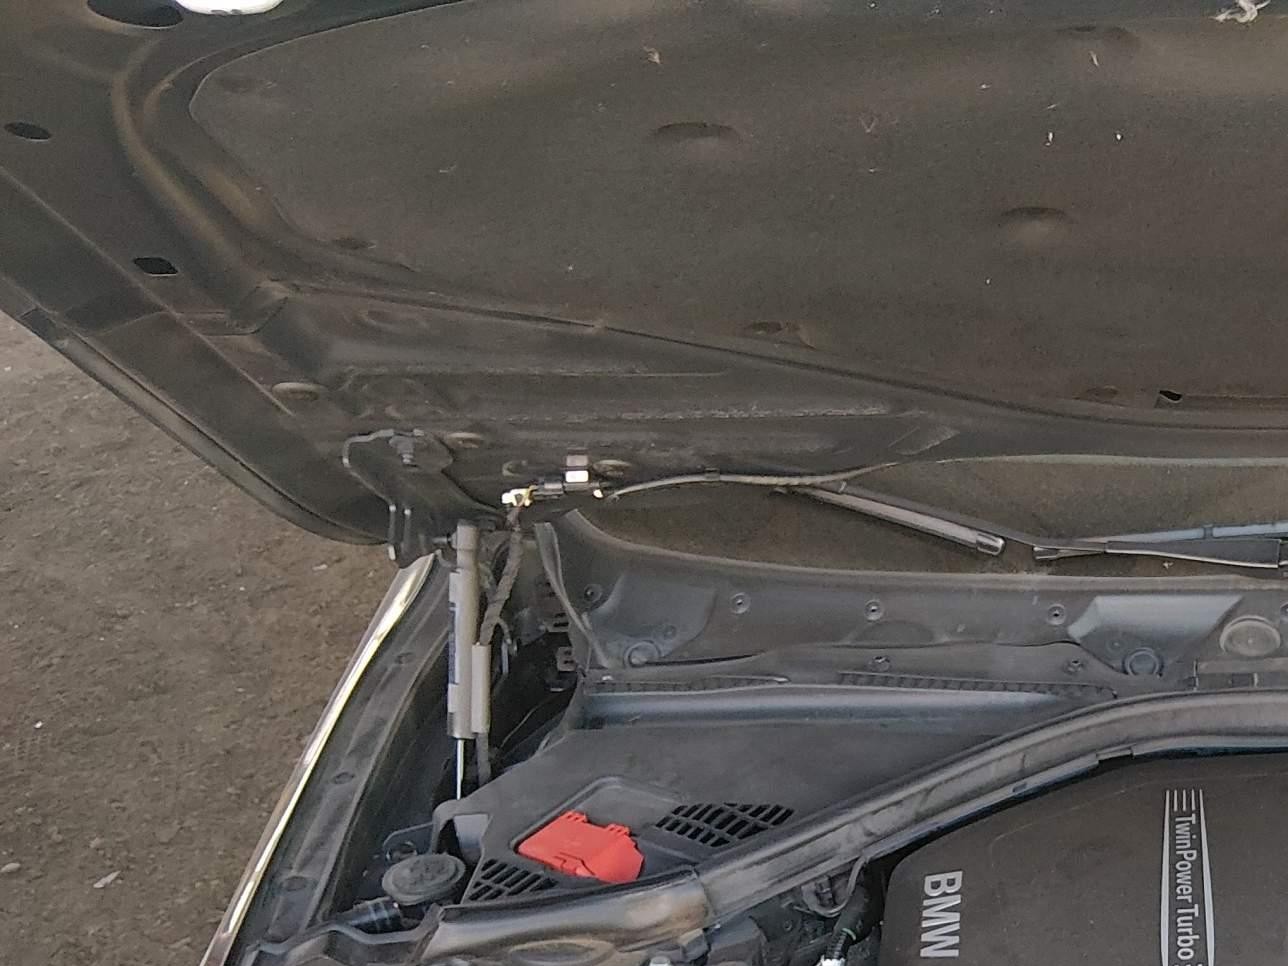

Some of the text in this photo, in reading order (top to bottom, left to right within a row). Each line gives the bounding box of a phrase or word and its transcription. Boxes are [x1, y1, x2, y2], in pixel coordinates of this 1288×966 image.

[920, 870, 963, 957] BMW
[1175, 813, 1200, 961] TwinPower Turbo
